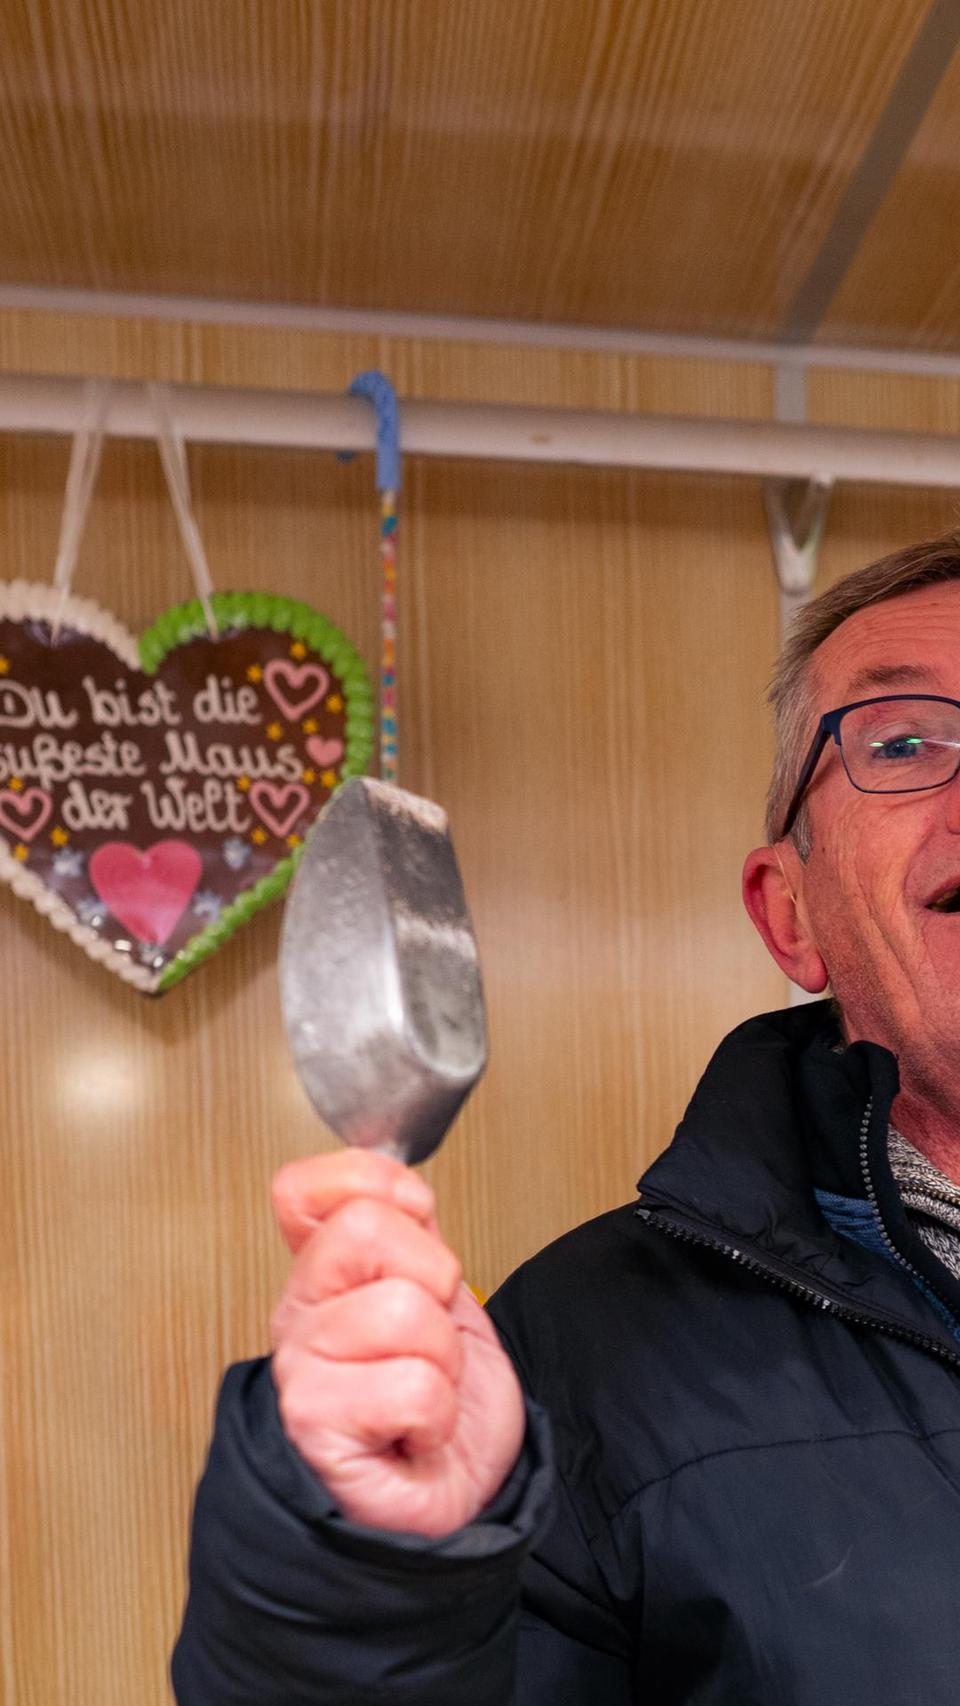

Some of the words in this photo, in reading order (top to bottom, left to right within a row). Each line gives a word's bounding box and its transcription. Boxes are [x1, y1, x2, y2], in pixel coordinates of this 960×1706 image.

[0, 679, 78, 730] Du
[82, 674, 181, 728] bist
[193, 673, 262, 726] die
[159, 730, 303, 783] Maus
[61, 779, 131, 831] der
[140, 779, 252, 833] Welt
